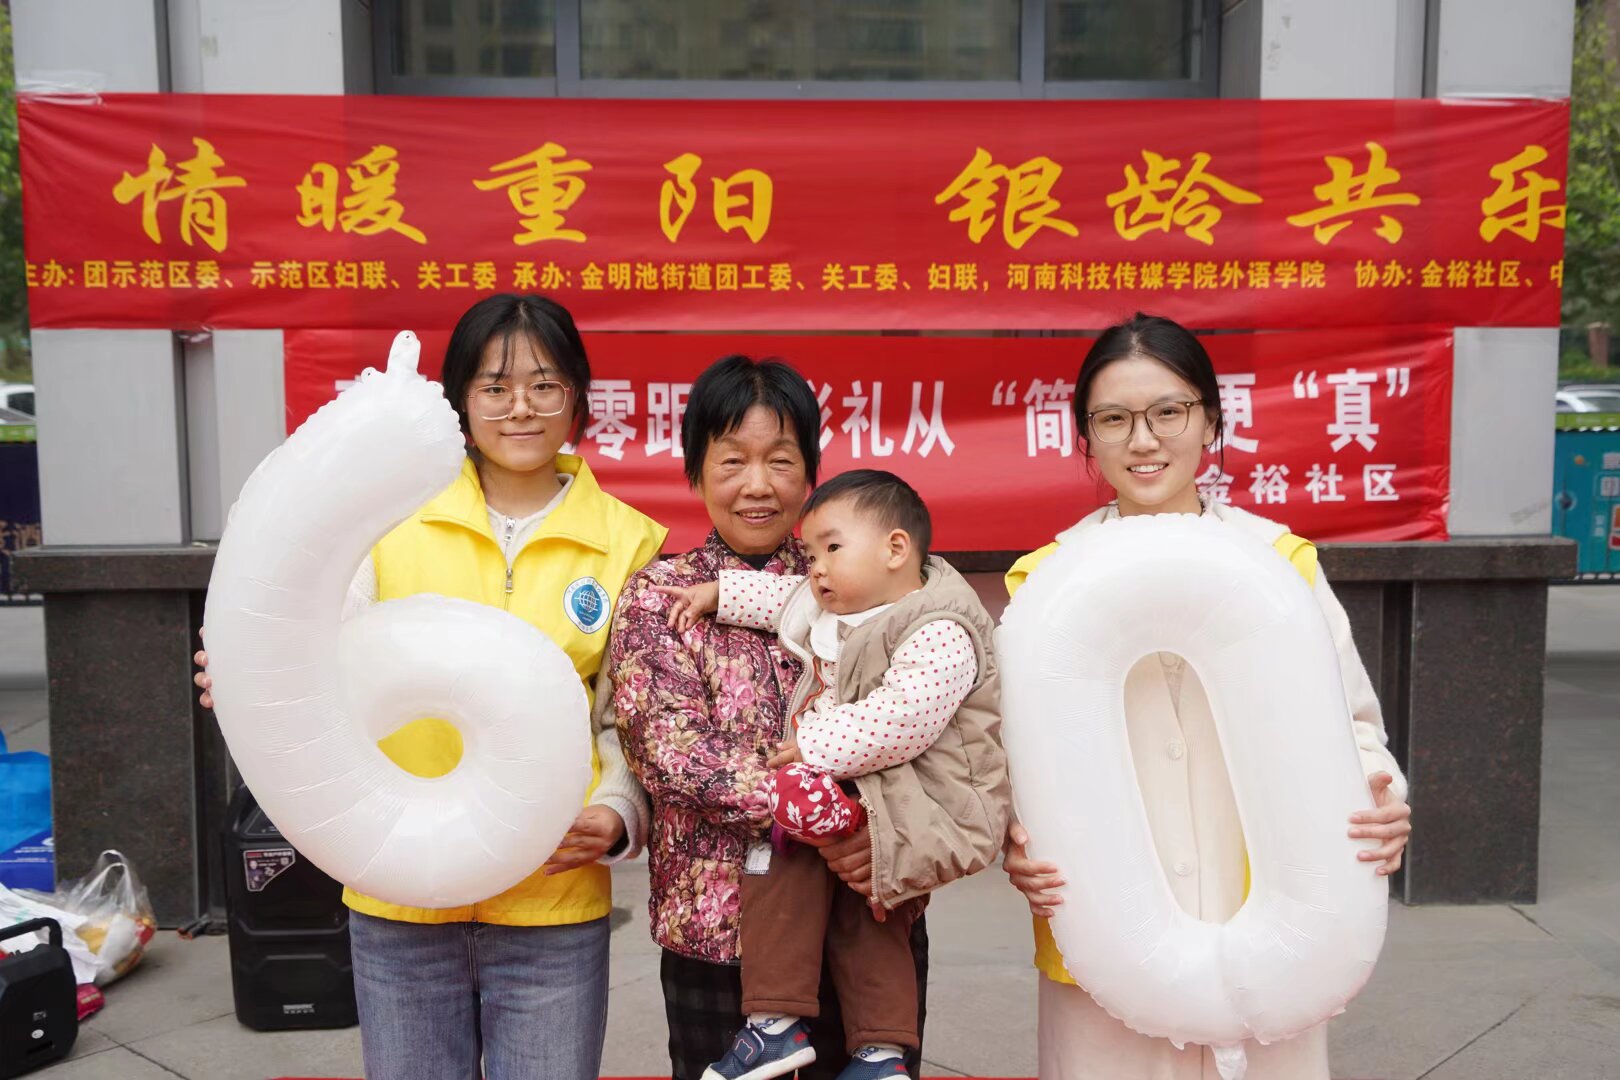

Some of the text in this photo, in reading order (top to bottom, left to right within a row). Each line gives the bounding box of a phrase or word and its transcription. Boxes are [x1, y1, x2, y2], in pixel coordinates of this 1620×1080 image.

[113, 137, 1568, 254] 情暖重阳 银龄共乐
[1195, 463, 1399, 504] 金裕社区
